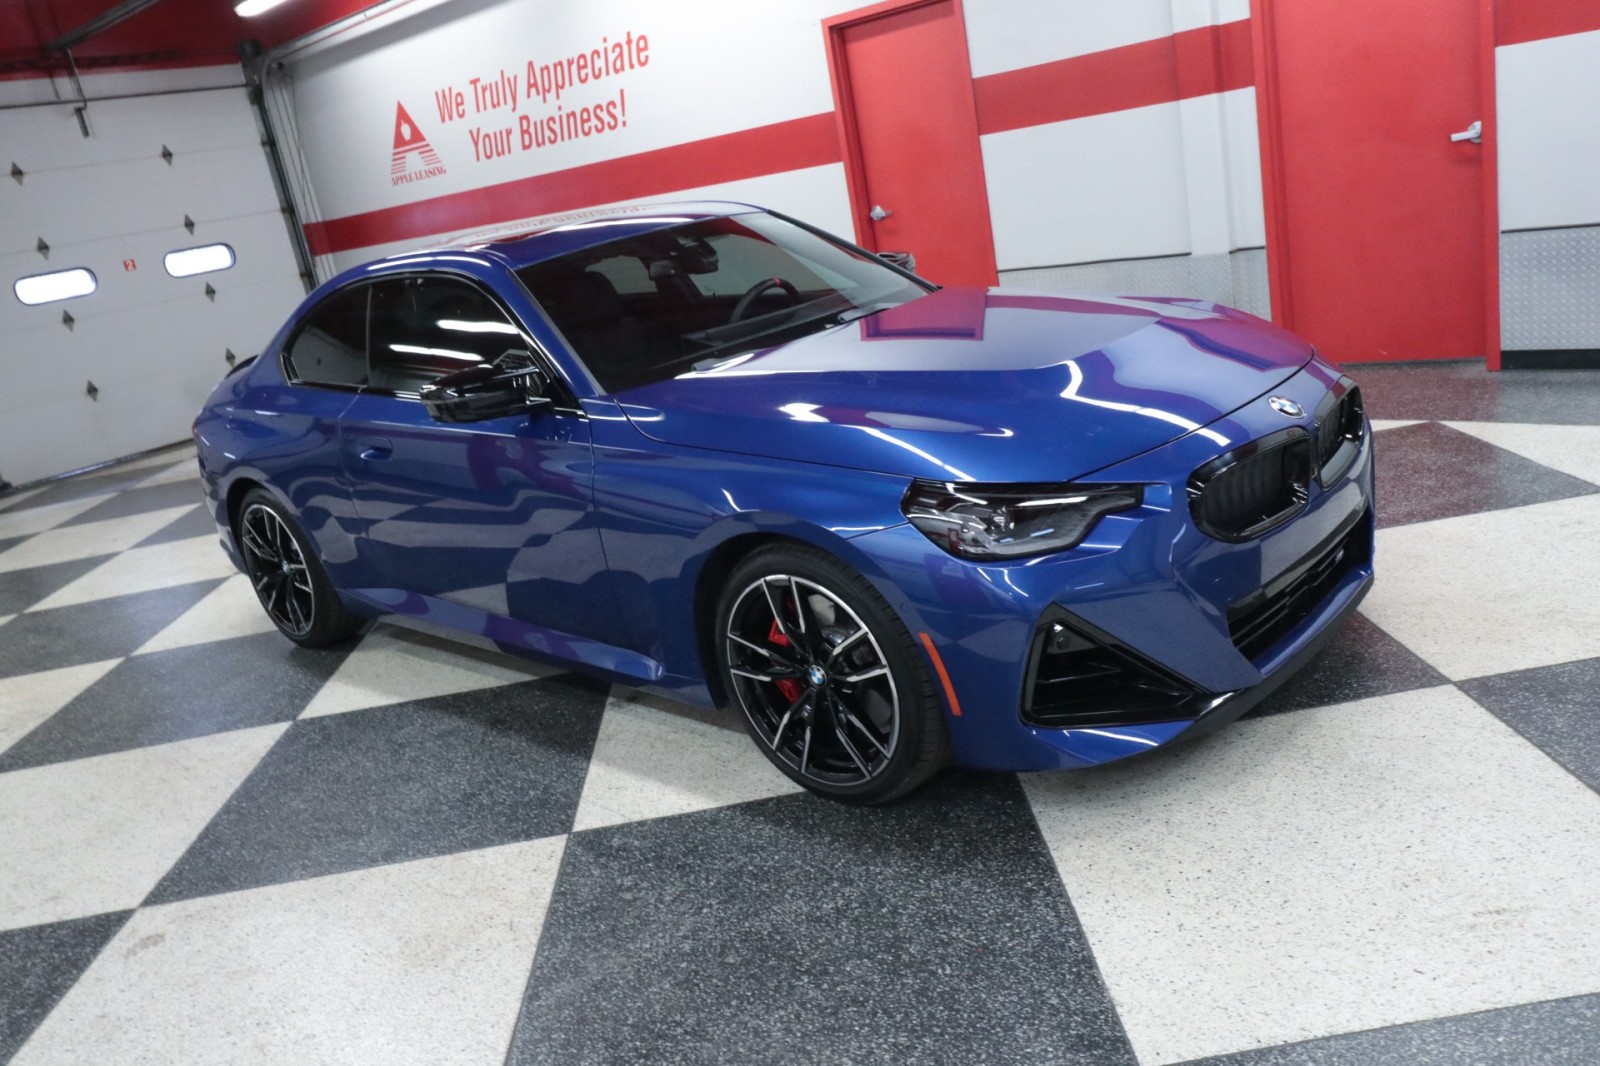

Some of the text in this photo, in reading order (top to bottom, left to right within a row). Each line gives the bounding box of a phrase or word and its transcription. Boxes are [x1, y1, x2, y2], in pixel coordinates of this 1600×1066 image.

[434, 31, 650, 123] We Truly Appreciate
[468, 88, 627, 162] Your Business!
[391, 166, 447, 186] APPLE LEASING
